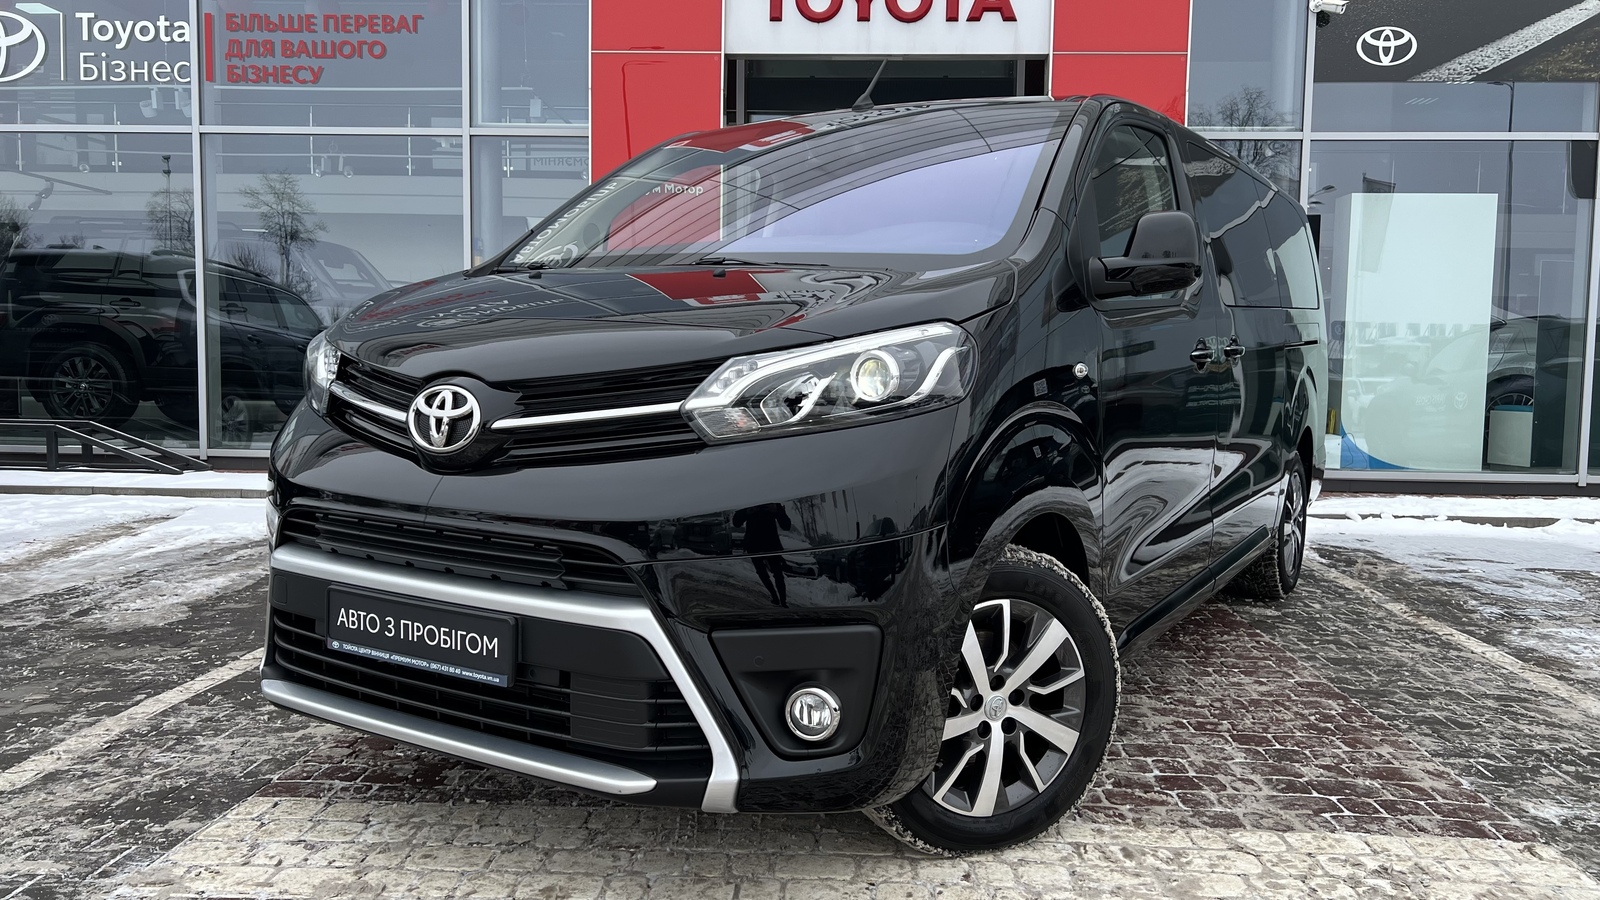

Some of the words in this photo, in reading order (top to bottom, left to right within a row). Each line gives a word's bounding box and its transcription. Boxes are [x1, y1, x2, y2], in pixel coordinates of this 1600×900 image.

[75, 12, 191, 49] Toyota
[225, 13, 316, 33] БІЛЬШЕ
[323, 14, 424, 34] ПЕРЕВАГ
[225, 39, 274, 60] ДЛЯ
[281, 39, 386, 59] ВАШОГО
[79, 52, 191, 82] Бізнес
[226, 65, 324, 83] БІЗНЕСУ
[664, 183, 704, 196] Мотор
[336, 607, 380, 634] АВТО
[399, 619, 499, 659] ПРОБІГОМ
